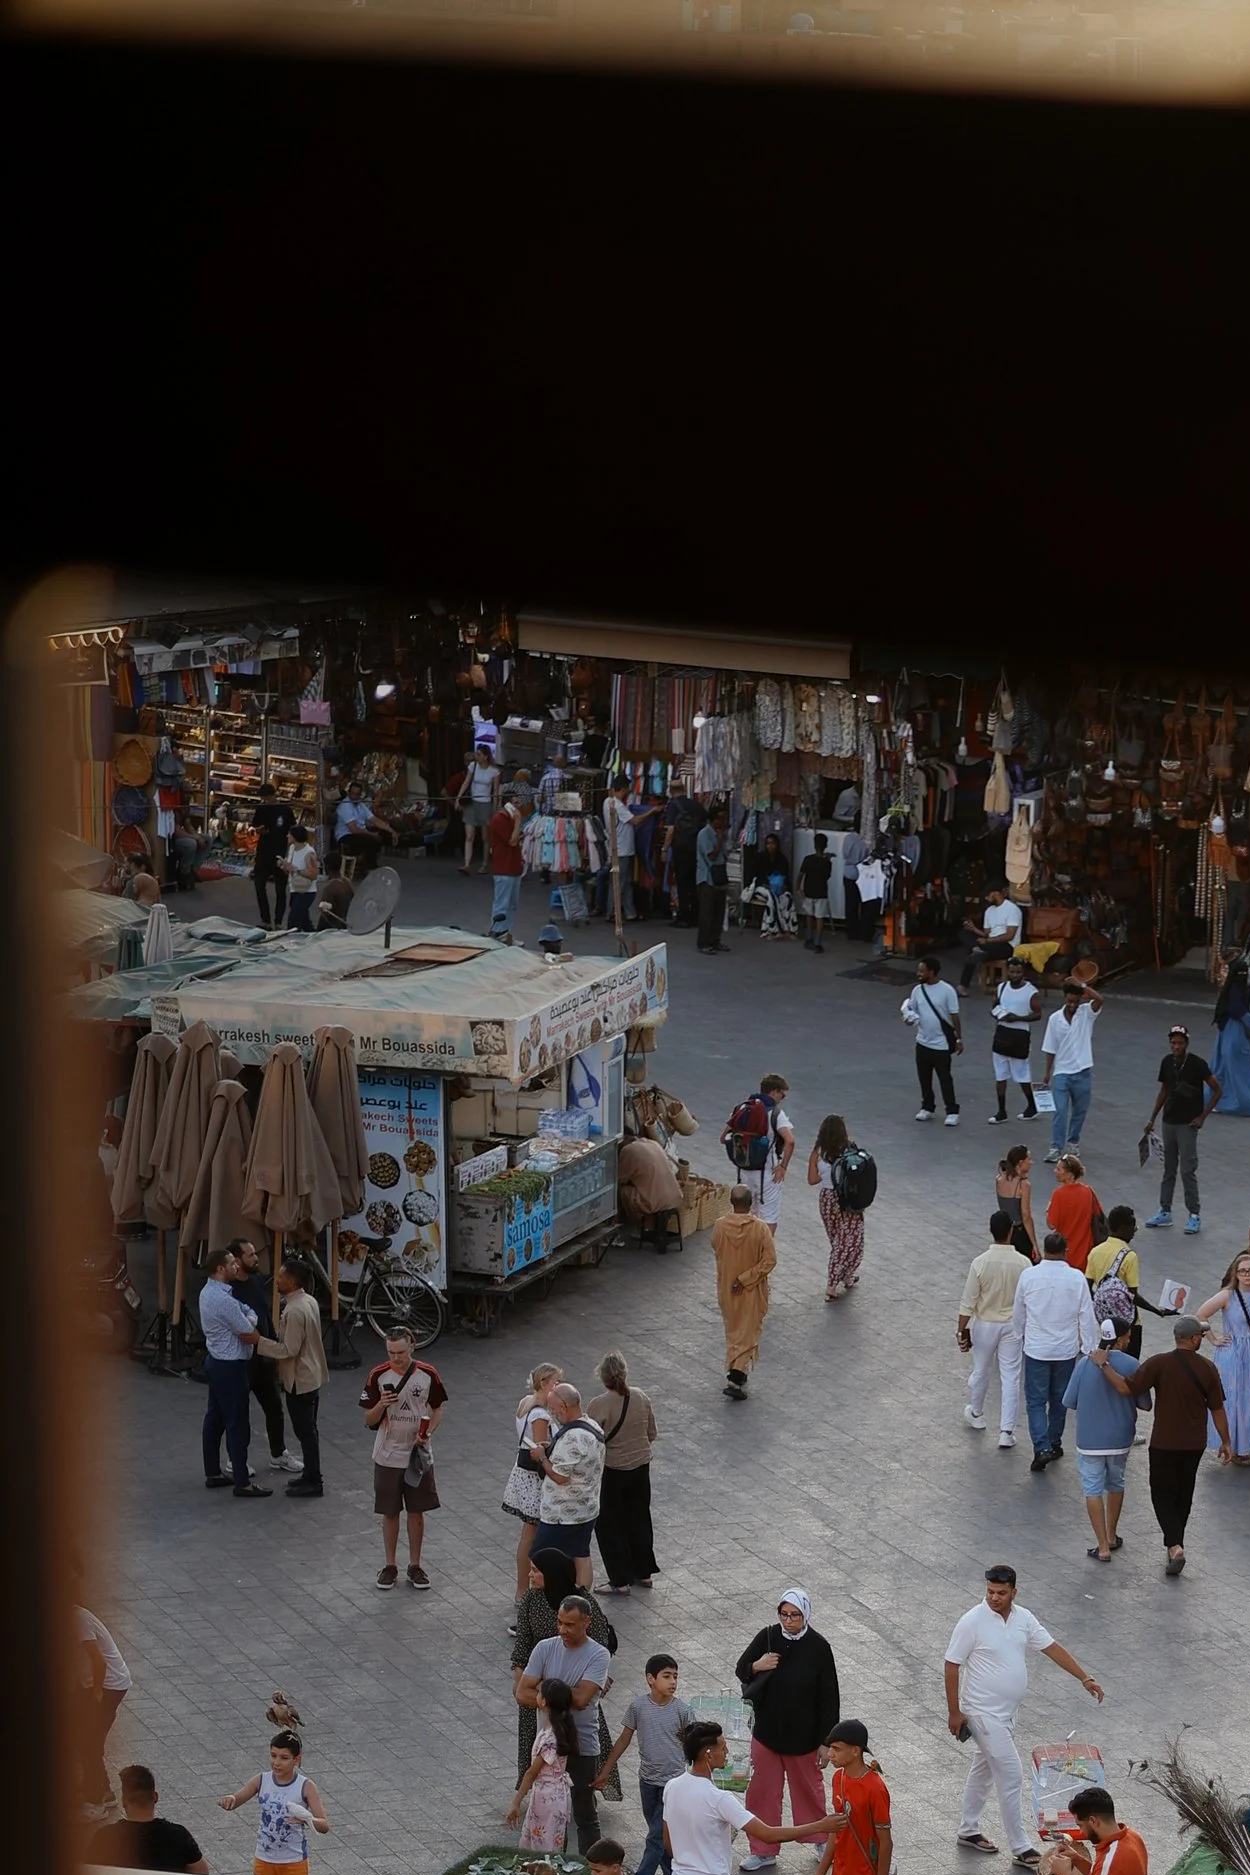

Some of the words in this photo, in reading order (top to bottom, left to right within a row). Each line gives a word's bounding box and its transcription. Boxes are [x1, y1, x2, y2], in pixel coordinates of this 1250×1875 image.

[618, 965, 639, 984] حلويات
[575, 1007, 595, 1024] Sweets
[216, 1028, 270, 1043] rrakesh
[275, 1032, 315, 1046] sweet
[360, 1036, 376, 1050] Mr
[382, 1037, 455, 1055] Bouassida
[358, 1074, 386, 1086] مراك
[361, 1111, 394, 1122] akech
[507, 1210, 550, 1247] samosa
